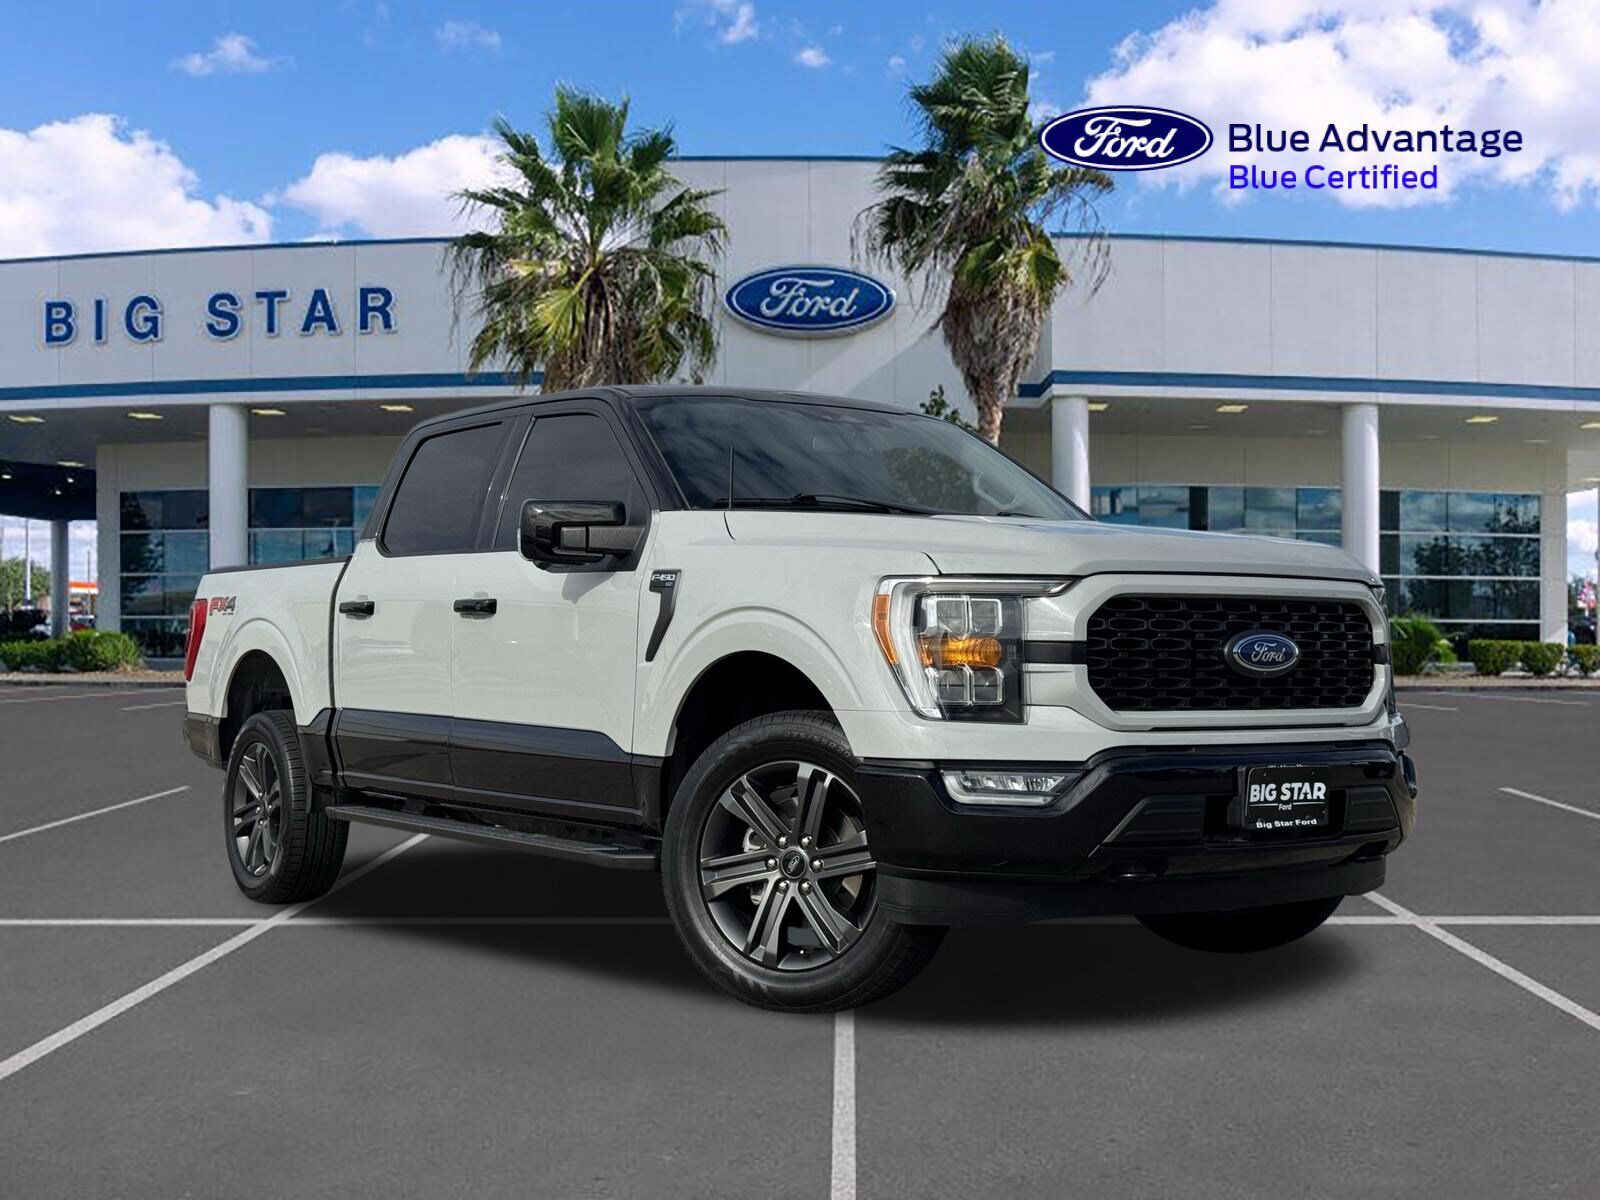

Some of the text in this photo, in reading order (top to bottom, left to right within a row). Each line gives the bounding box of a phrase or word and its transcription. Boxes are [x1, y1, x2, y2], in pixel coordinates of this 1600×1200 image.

[759, 277, 860, 318] Ford
[44, 286, 396, 345] BIG STAR
[651, 573, 676, 582] F-150
[209, 595, 237, 616] FX4
[1250, 641, 1286, 662] Ford
[1249, 782, 1327, 803] BIG STAR
[1278, 803, 1293, 811] Ford
[1255, 818, 1318, 829] Big Star Ford
